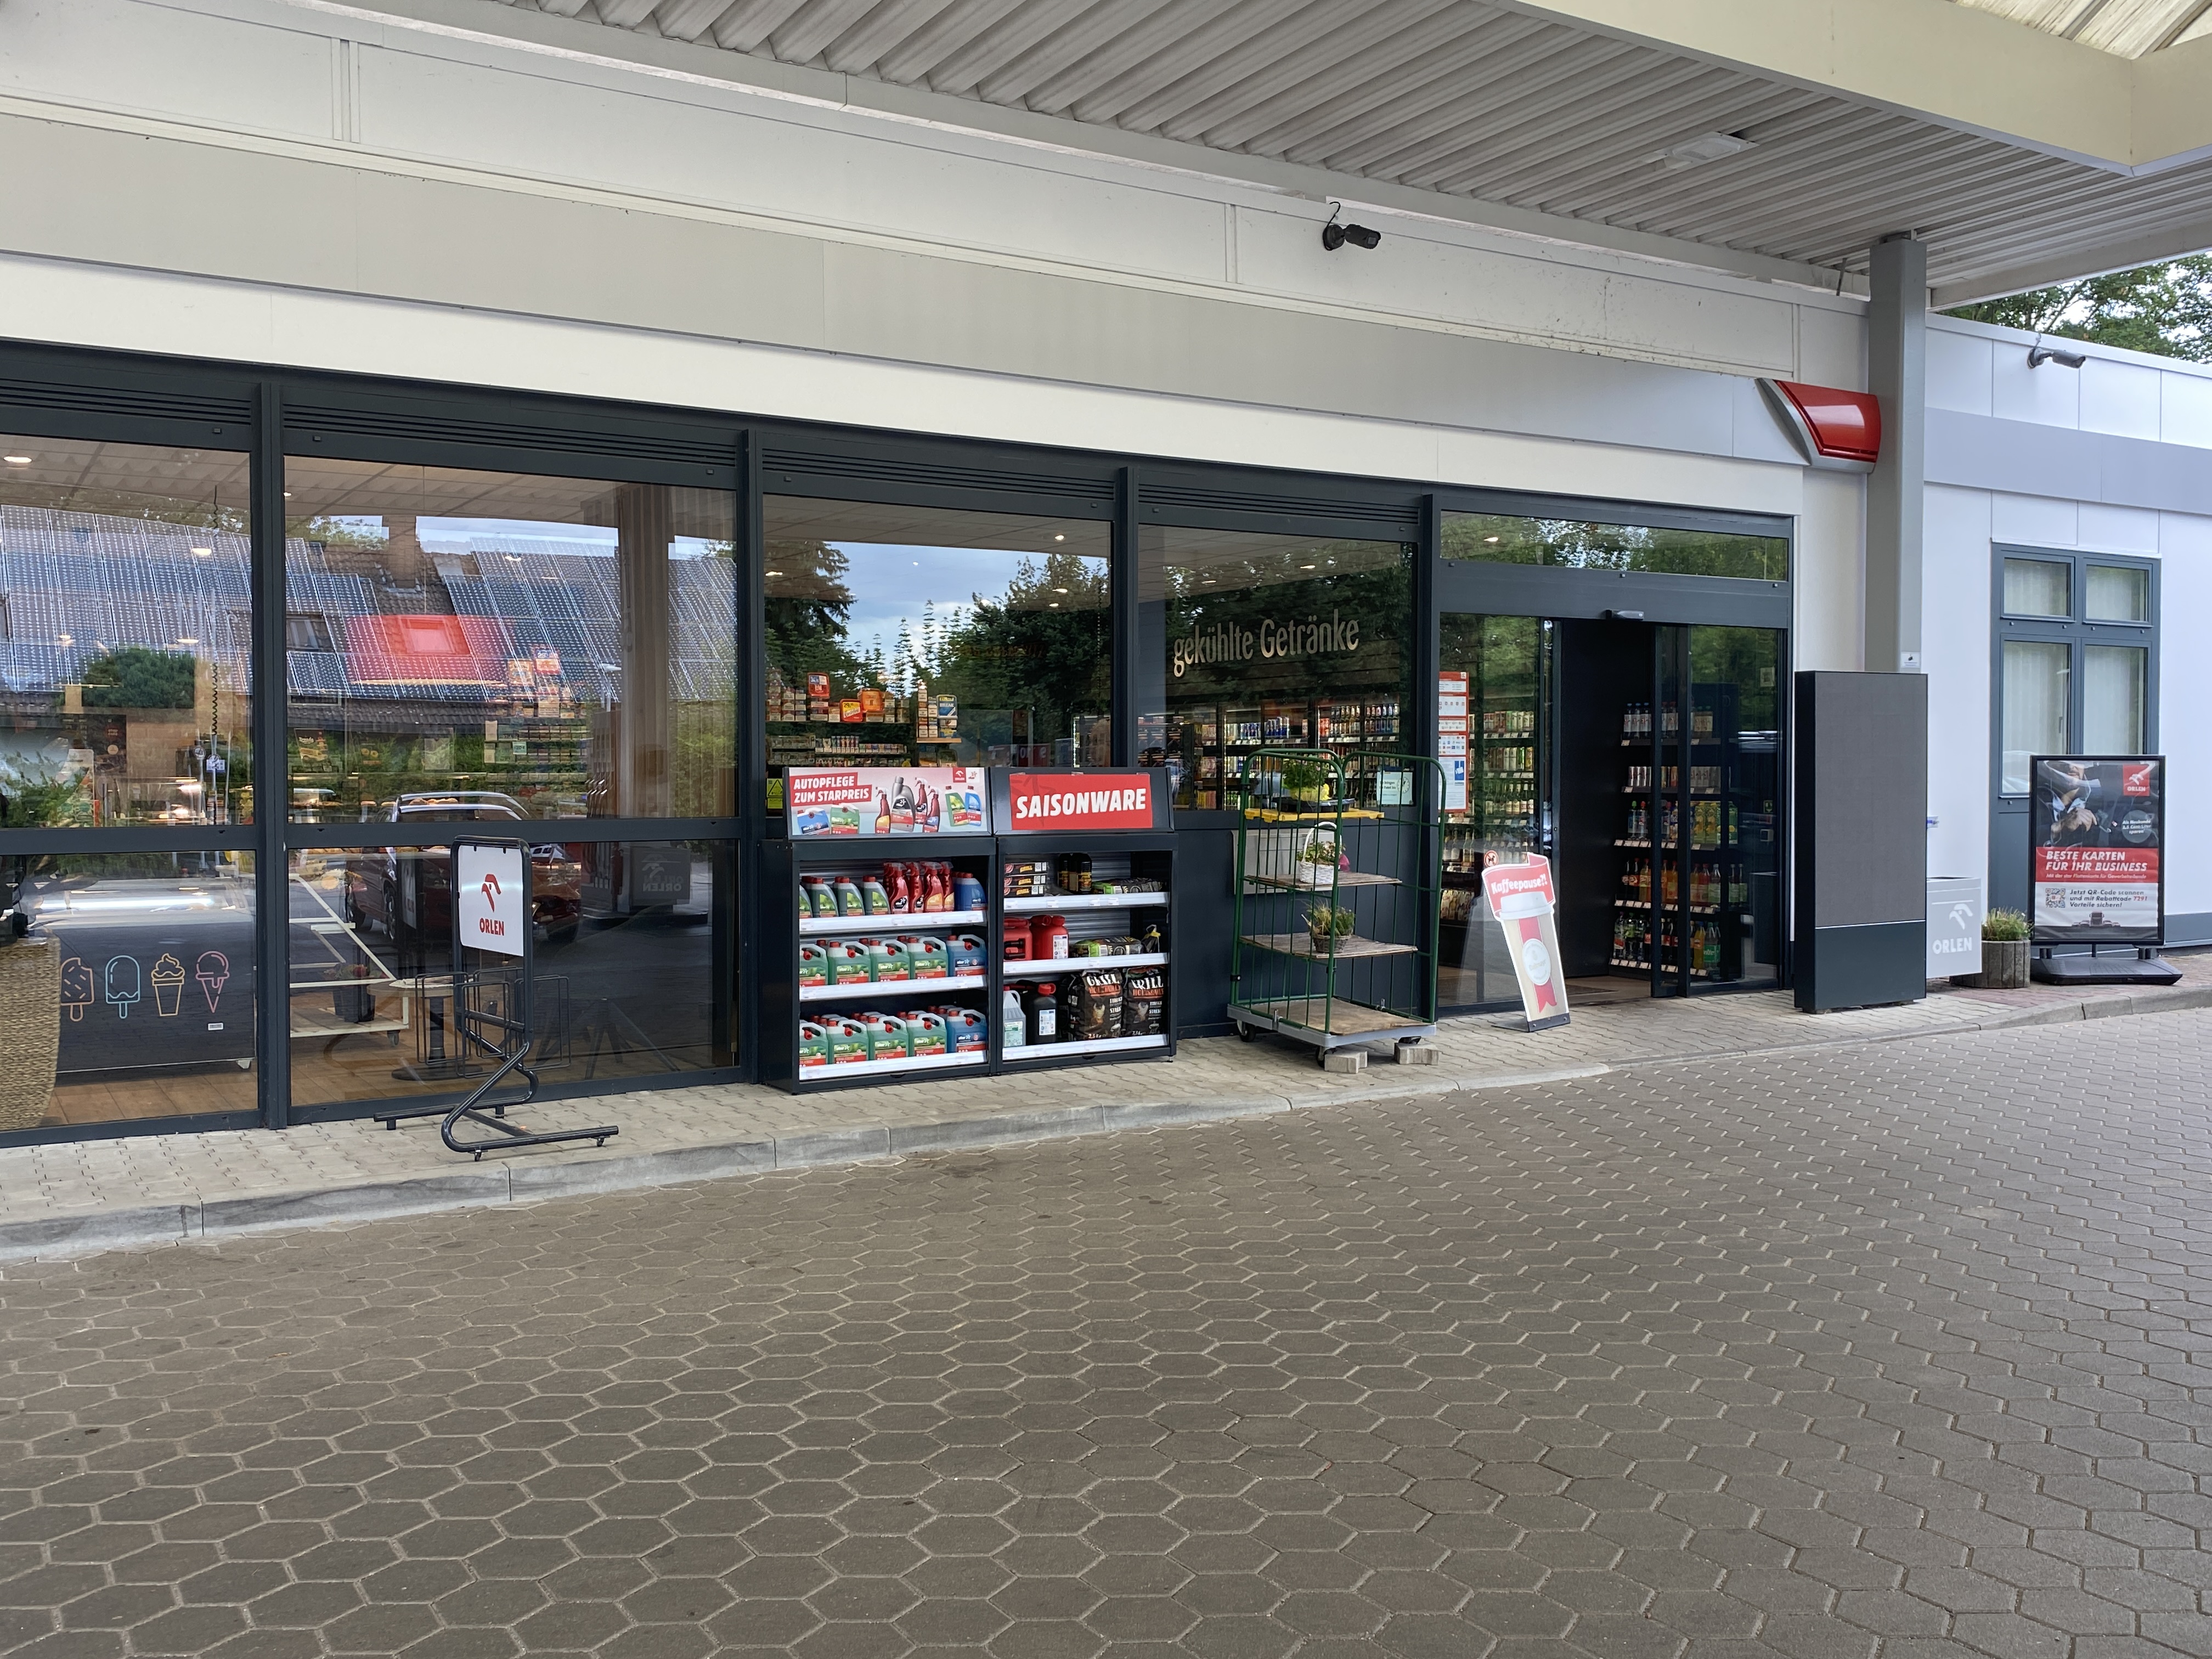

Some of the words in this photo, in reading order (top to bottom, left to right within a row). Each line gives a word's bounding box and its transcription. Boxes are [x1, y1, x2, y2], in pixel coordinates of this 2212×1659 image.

[1173, 622, 1254, 677] gekühlte
[1261, 608, 1360, 658] Getränke
[793, 776, 855, 790] AUTOPFLEGE
[794, 791, 816, 803] ZUM
[817, 788, 870, 802] STARPREIS
[1015, 788, 1147, 819] SAISONWARE
[2046, 851, 2079, 860] BESTE
[2081, 851, 2125, 861] KARTEN
[2045, 860, 2068, 871] FÜR
[2071, 861, 2092, 871] IHR
[2095, 862, 2148, 872] BUSINESS
[1490, 873, 1548, 895] Kaffeepause?!
[479, 917, 505, 936] ORLEN
[1932, 937, 1973, 955] ORLEN
